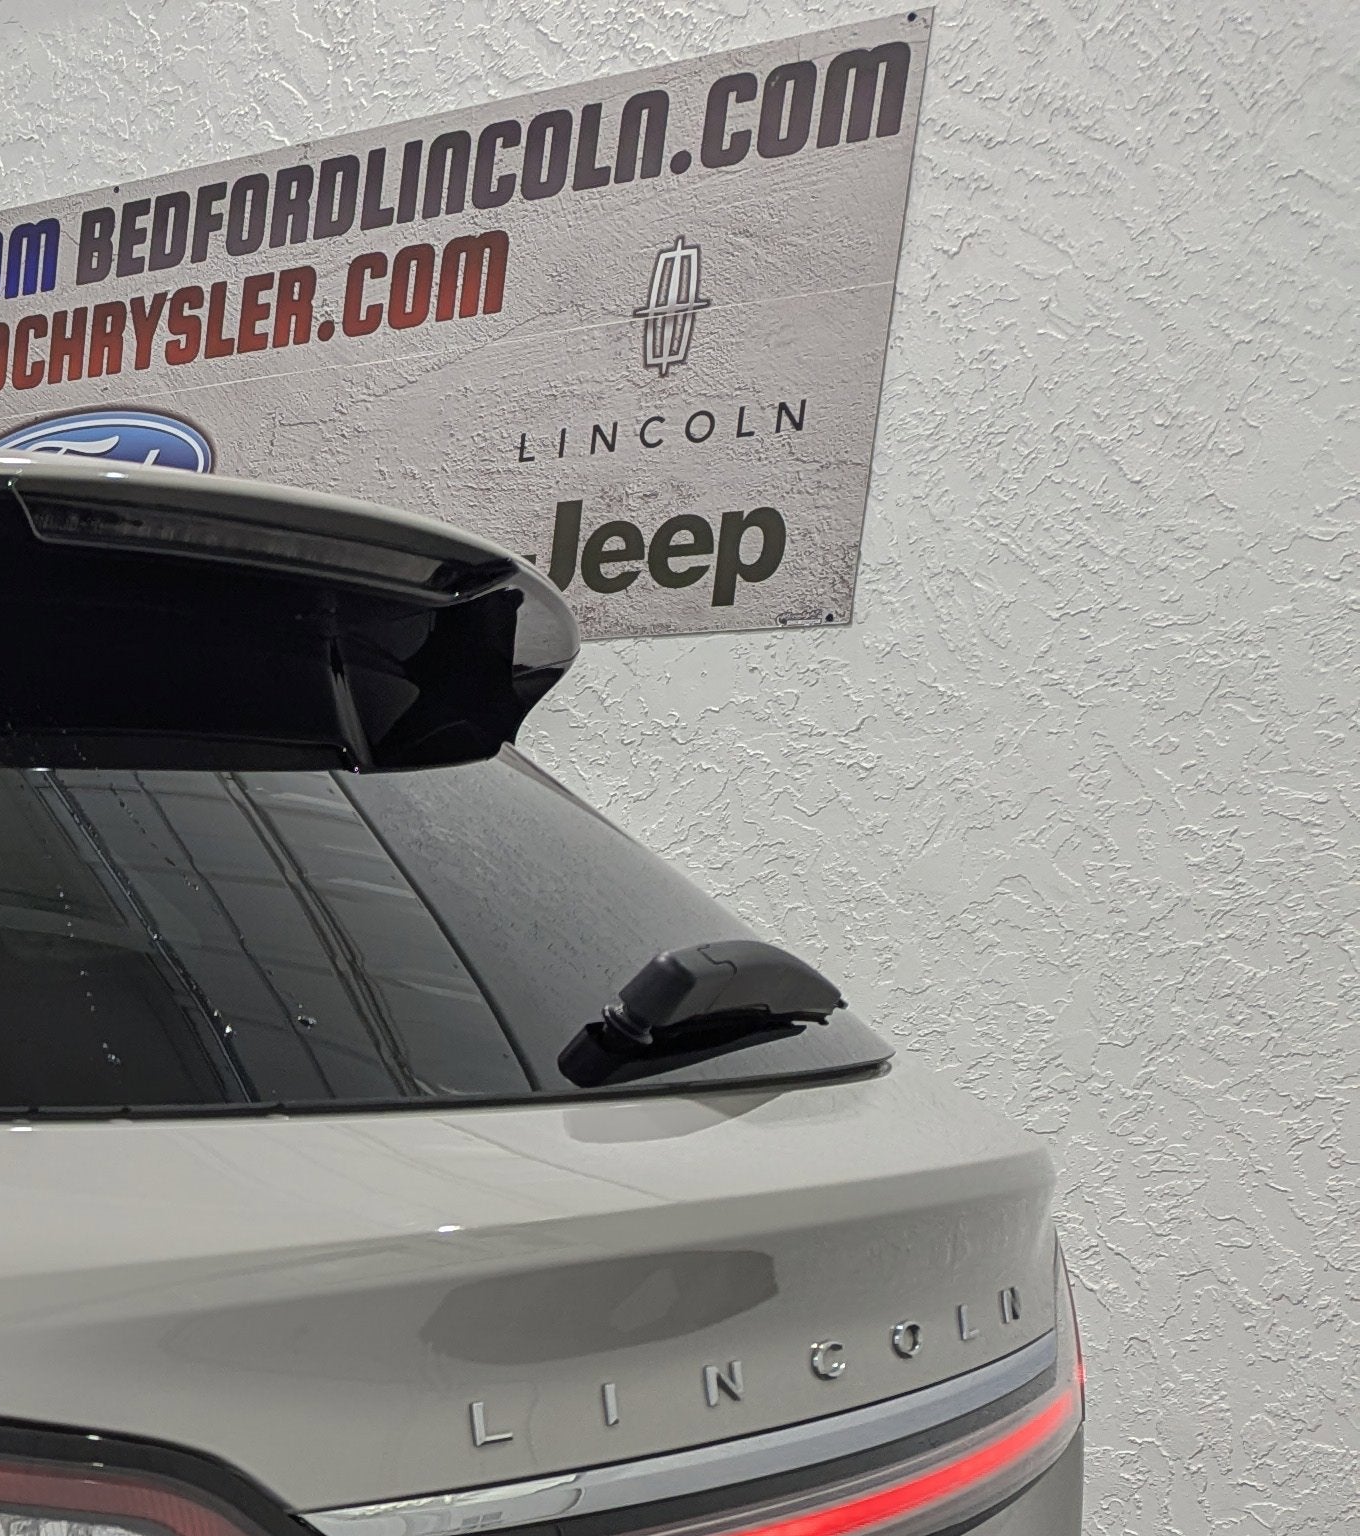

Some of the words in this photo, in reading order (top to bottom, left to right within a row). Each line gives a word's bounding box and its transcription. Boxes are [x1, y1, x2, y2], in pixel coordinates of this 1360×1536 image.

[75, 40, 912, 285] BEDFORDLINCOLN.COM
[518, 399, 807, 463] LINCOLN
[523, 500, 787, 607] Jeep
[469, 1285, 1024, 1447] LINCOLN
